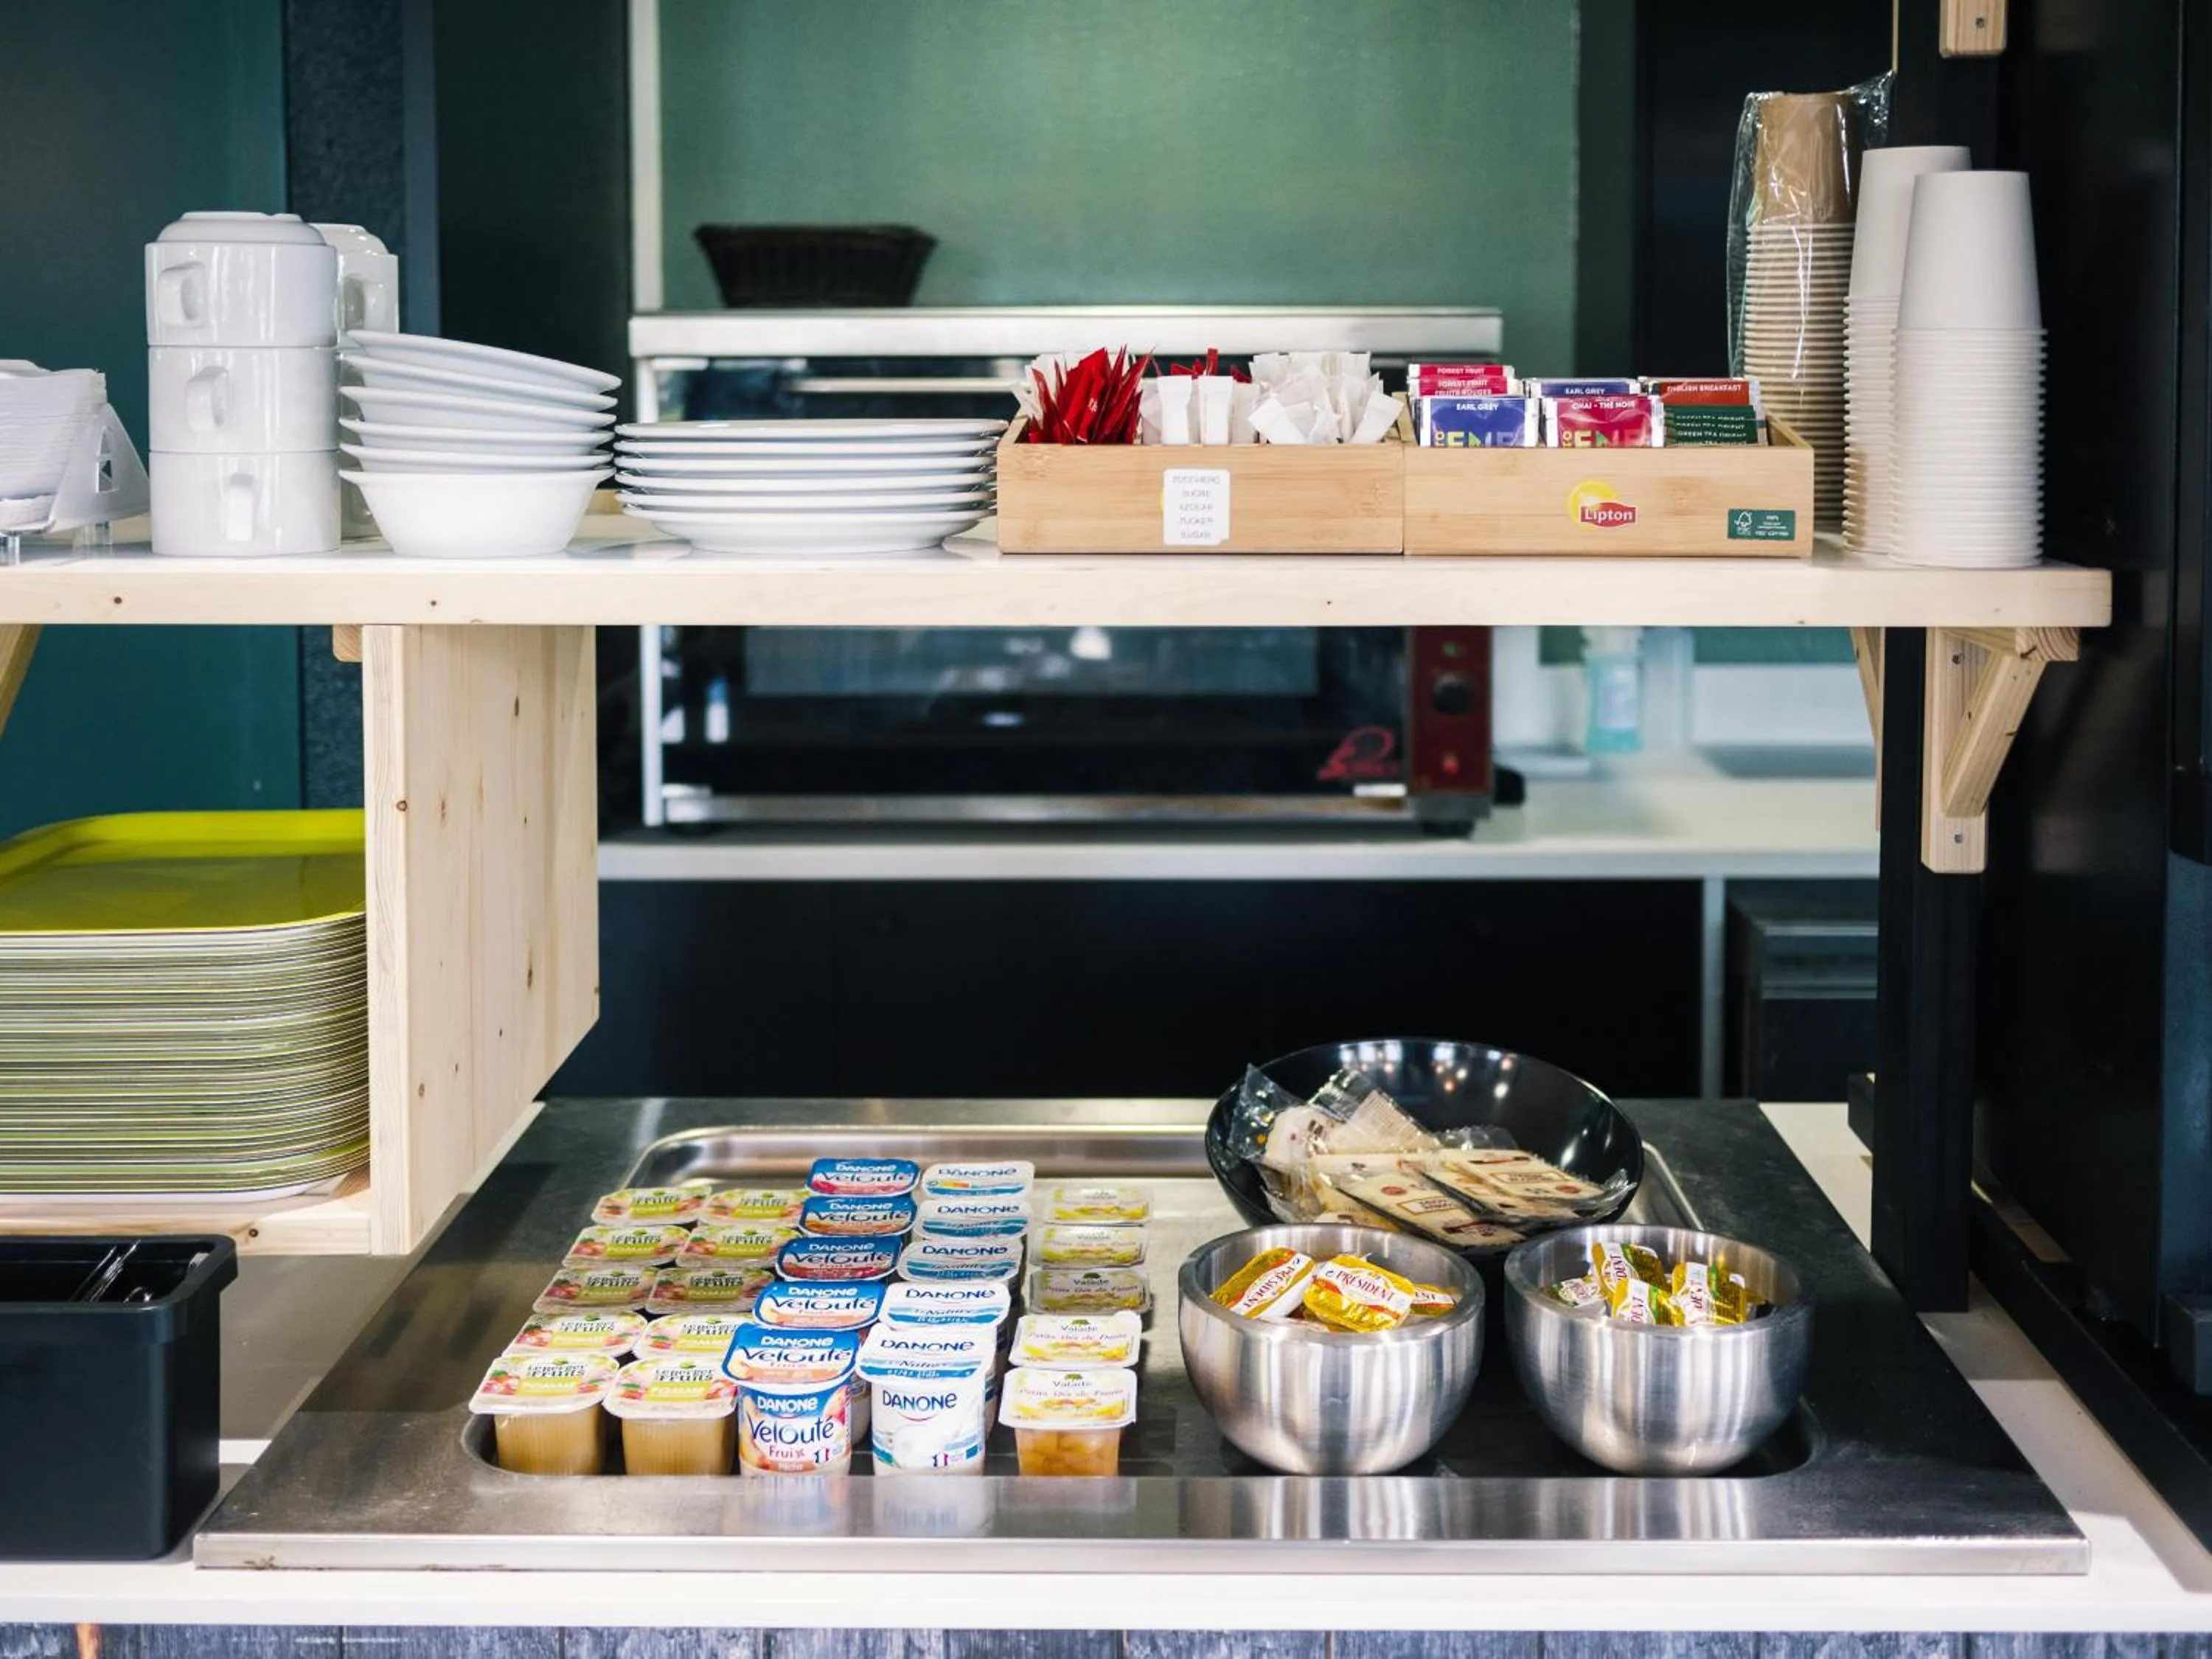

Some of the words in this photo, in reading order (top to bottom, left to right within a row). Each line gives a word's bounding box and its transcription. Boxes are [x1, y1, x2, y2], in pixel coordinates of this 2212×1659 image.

[1585, 507, 1633, 523] Lipton
[836, 1164, 897, 1172] DANONE
[939, 1167, 1018, 1178] DANONE
[821, 1171, 911, 1183] Velouté
[937, 1205, 1020, 1214] DANONE
[813, 1210, 910, 1222] Velouté
[809, 1242, 875, 1251] DANONE
[922, 1245, 1008, 1255] DANONE
[791, 1251, 892, 1264] Velouté
[788, 1287, 858, 1298] DANONE
[906, 1287, 995, 1299] DANONE
[770, 1295, 875, 1310] Velouté
[760, 1335, 834, 1347] DANONE
[880, 1339, 975, 1352] DANONE
[739, 1346, 851, 1363] Velouté
[1051, 1380, 1093, 1388] Valade
[757, 1396, 818, 1412] DANONE
[883, 1389, 958, 1411] DANONE
[746, 1411, 834, 1444] Velouté
